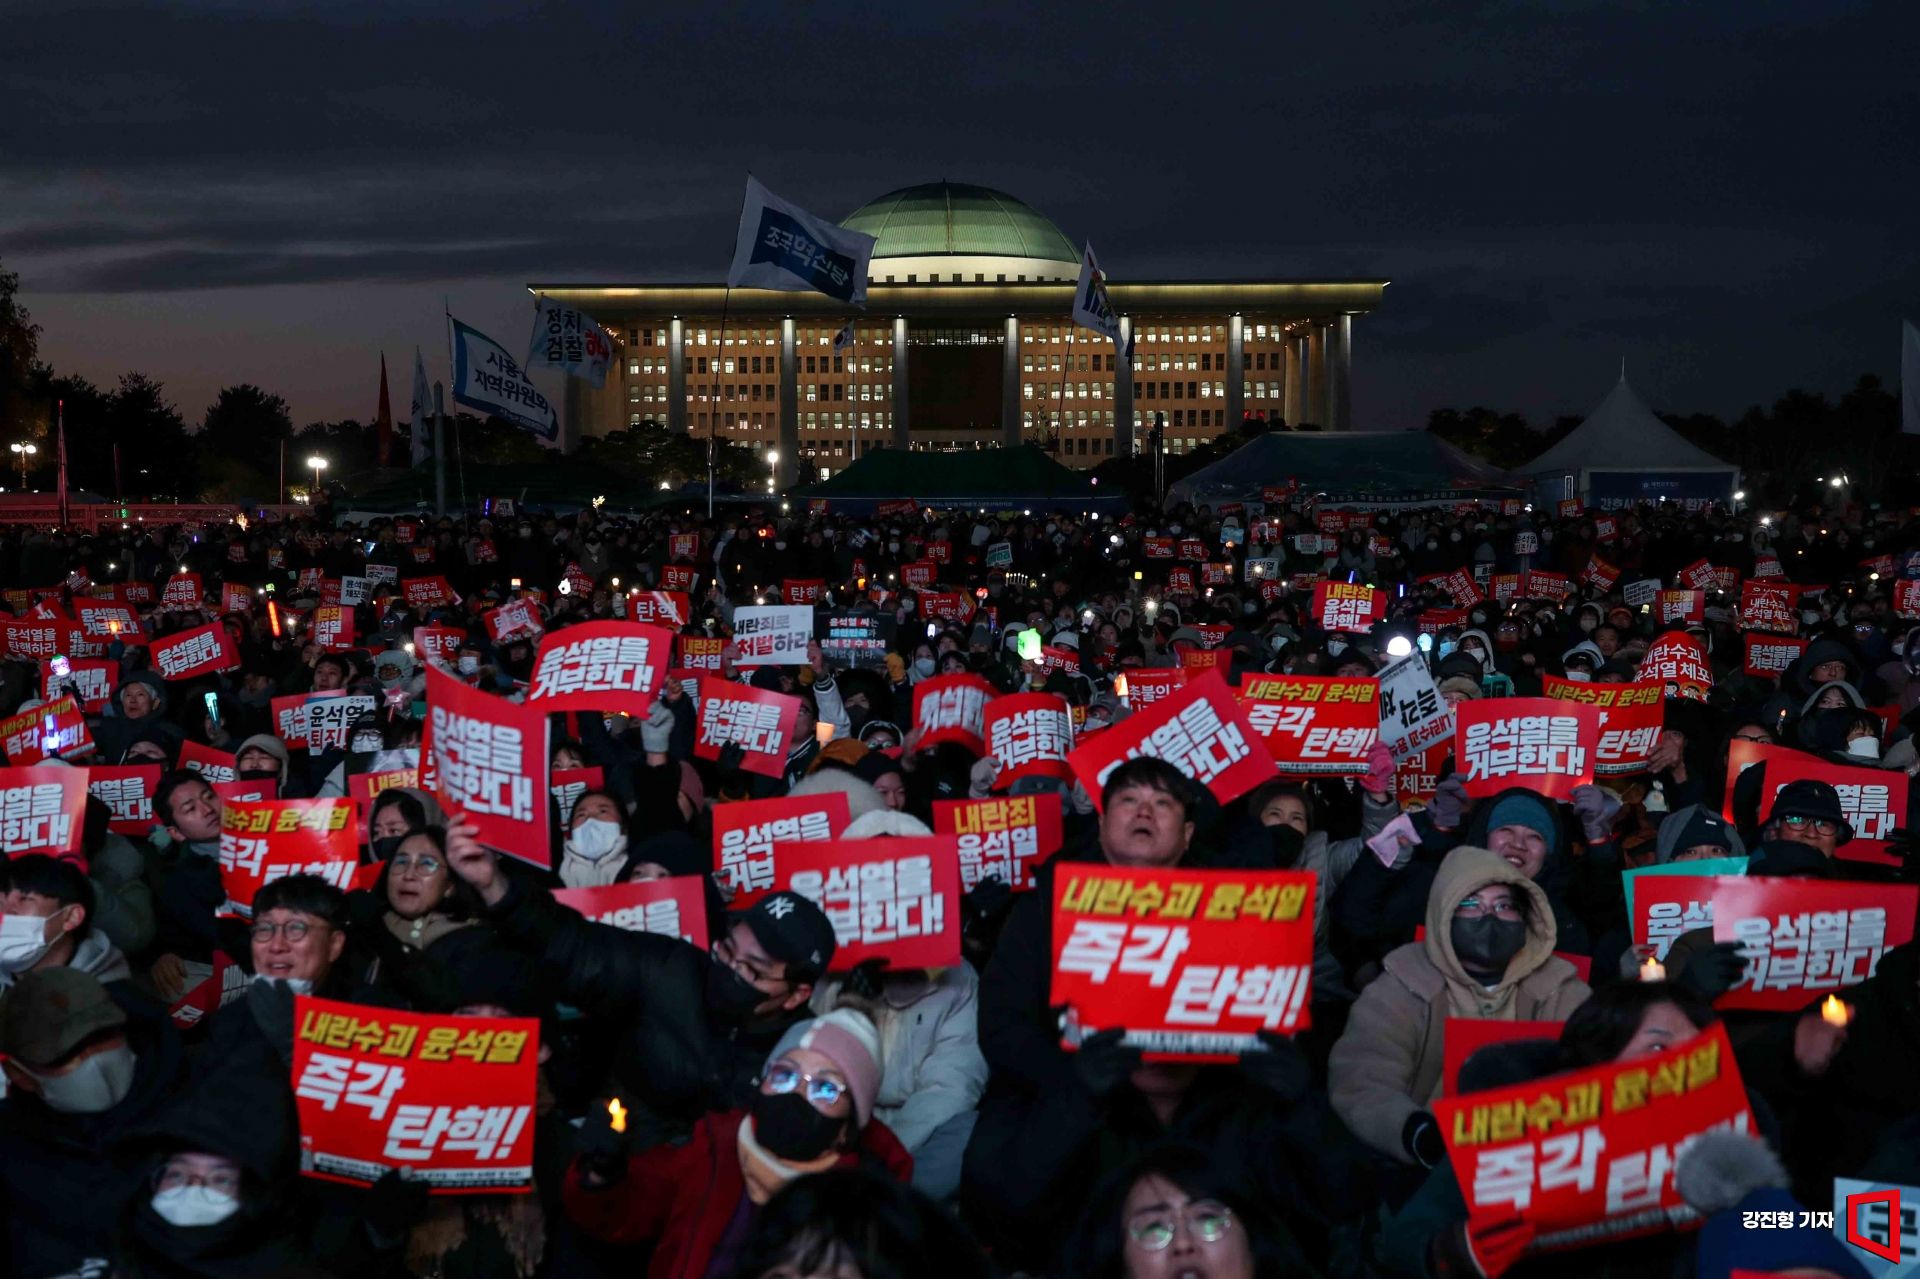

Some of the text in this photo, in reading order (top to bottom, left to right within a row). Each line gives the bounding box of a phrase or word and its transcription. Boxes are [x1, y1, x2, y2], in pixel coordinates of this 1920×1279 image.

[764, 225, 850, 287] 조국혁신당
[547, 308, 581, 335] 정치
[547, 337, 583, 362] 검찰
[475, 369, 549, 415] 지역위원회
[126, 586, 150, 601] 탄핵
[668, 570, 689, 585] 탄핵
[790, 586, 819, 602] 탄핵
[1325, 583, 1374, 600] 내란죄
[81, 607, 130, 622] 윤석열을
[636, 599, 679, 623] 탄핵
[1322, 614, 1360, 631] 탄핵!
[1324, 598, 1373, 615] 윤석열
[6, 627, 57, 641] 윤석열을
[734, 614, 790, 634] 내란죄로
[1200, 631, 1225, 642] 란수괴
[8, 641, 58, 655] 탄핵하라
[157, 631, 215, 663] 윤석열을
[161, 643, 222, 677] 거부한다!
[538, 636, 649, 681] 윤석열을
[682, 638, 722, 654] 내란죄
[682, 654, 722, 670] 윤석열
[1750, 644, 1801, 664] 윤석열을
[530, 663, 655, 700] 거부한다!
[1245, 682, 1377, 704] 내란수괴 윤석열
[1547, 684, 1663, 706] 내란수괴 윤석열
[310, 704, 364, 727] 윤석열
[703, 698, 782, 731] 윤석열을
[1247, 704, 1317, 738] 즉각
[6, 731, 40, 756] 즉각
[432, 705, 523, 774] 윤석열을
[1299, 725, 1377, 759] 탄핵!
[1465, 716, 1579, 750] 윤석열을
[1465, 744, 1586, 782] 거부한다!
[954, 796, 1036, 834] 내란죄
[956, 826, 1038, 861] 윤석열
[1061, 877, 1308, 921] 내란수괴 윤석열
[835, 892, 945, 947] 부한다!
[1734, 907, 1886, 949] 윤석열을
[1058, 919, 1191, 988] 즉각
[1165, 964, 1311, 1030] 탄핵!
[300, 1010, 527, 1063] 내란수괴 윤석열
[295, 1052, 405, 1120] 즉각
[1454, 1038, 1722, 1146] 내란수괴 윤석열
[383, 1104, 531, 1160] 탄핵!
[1474, 1125, 1606, 1210] 즉각
